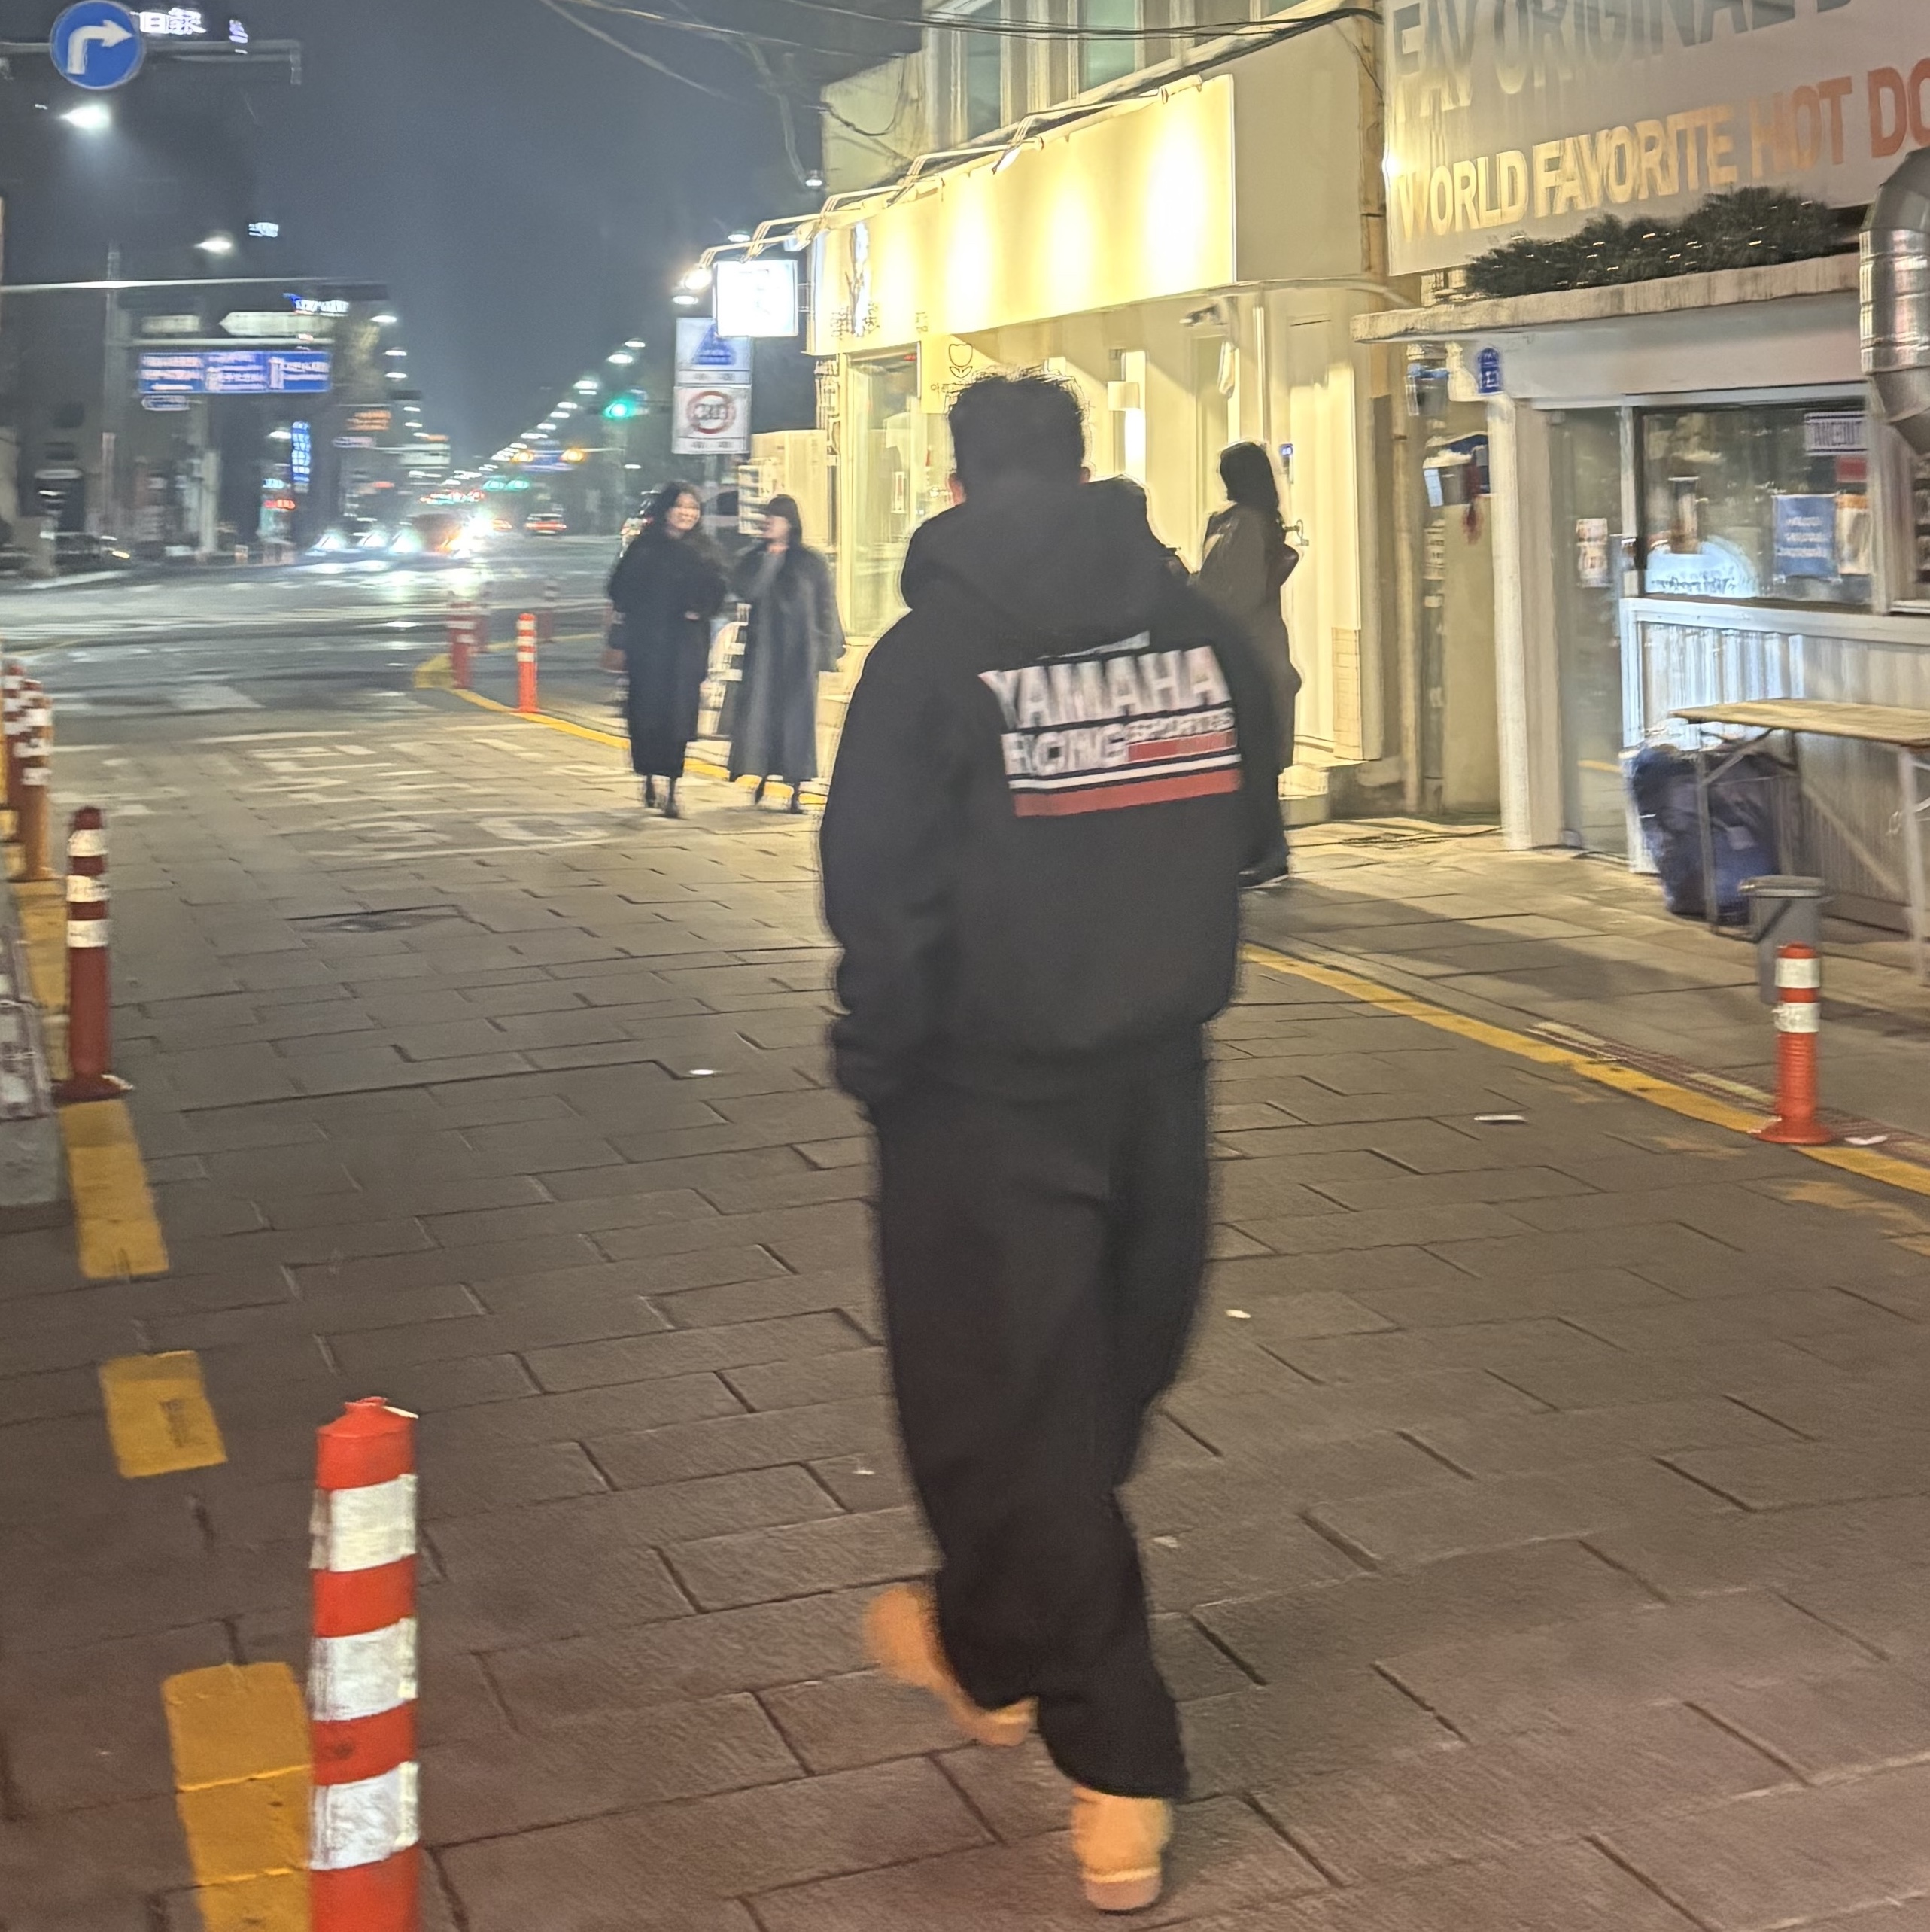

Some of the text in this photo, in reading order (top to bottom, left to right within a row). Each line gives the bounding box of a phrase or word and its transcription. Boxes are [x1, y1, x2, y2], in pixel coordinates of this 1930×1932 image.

[1493, 0, 1796, 95] ORIGI
[1397, 151, 1528, 242] WORLD
[1533, 105, 1737, 218] FAVORITE
[1749, 76, 1852, 179] HOT
[977, 646, 1232, 729] YAMAHA
